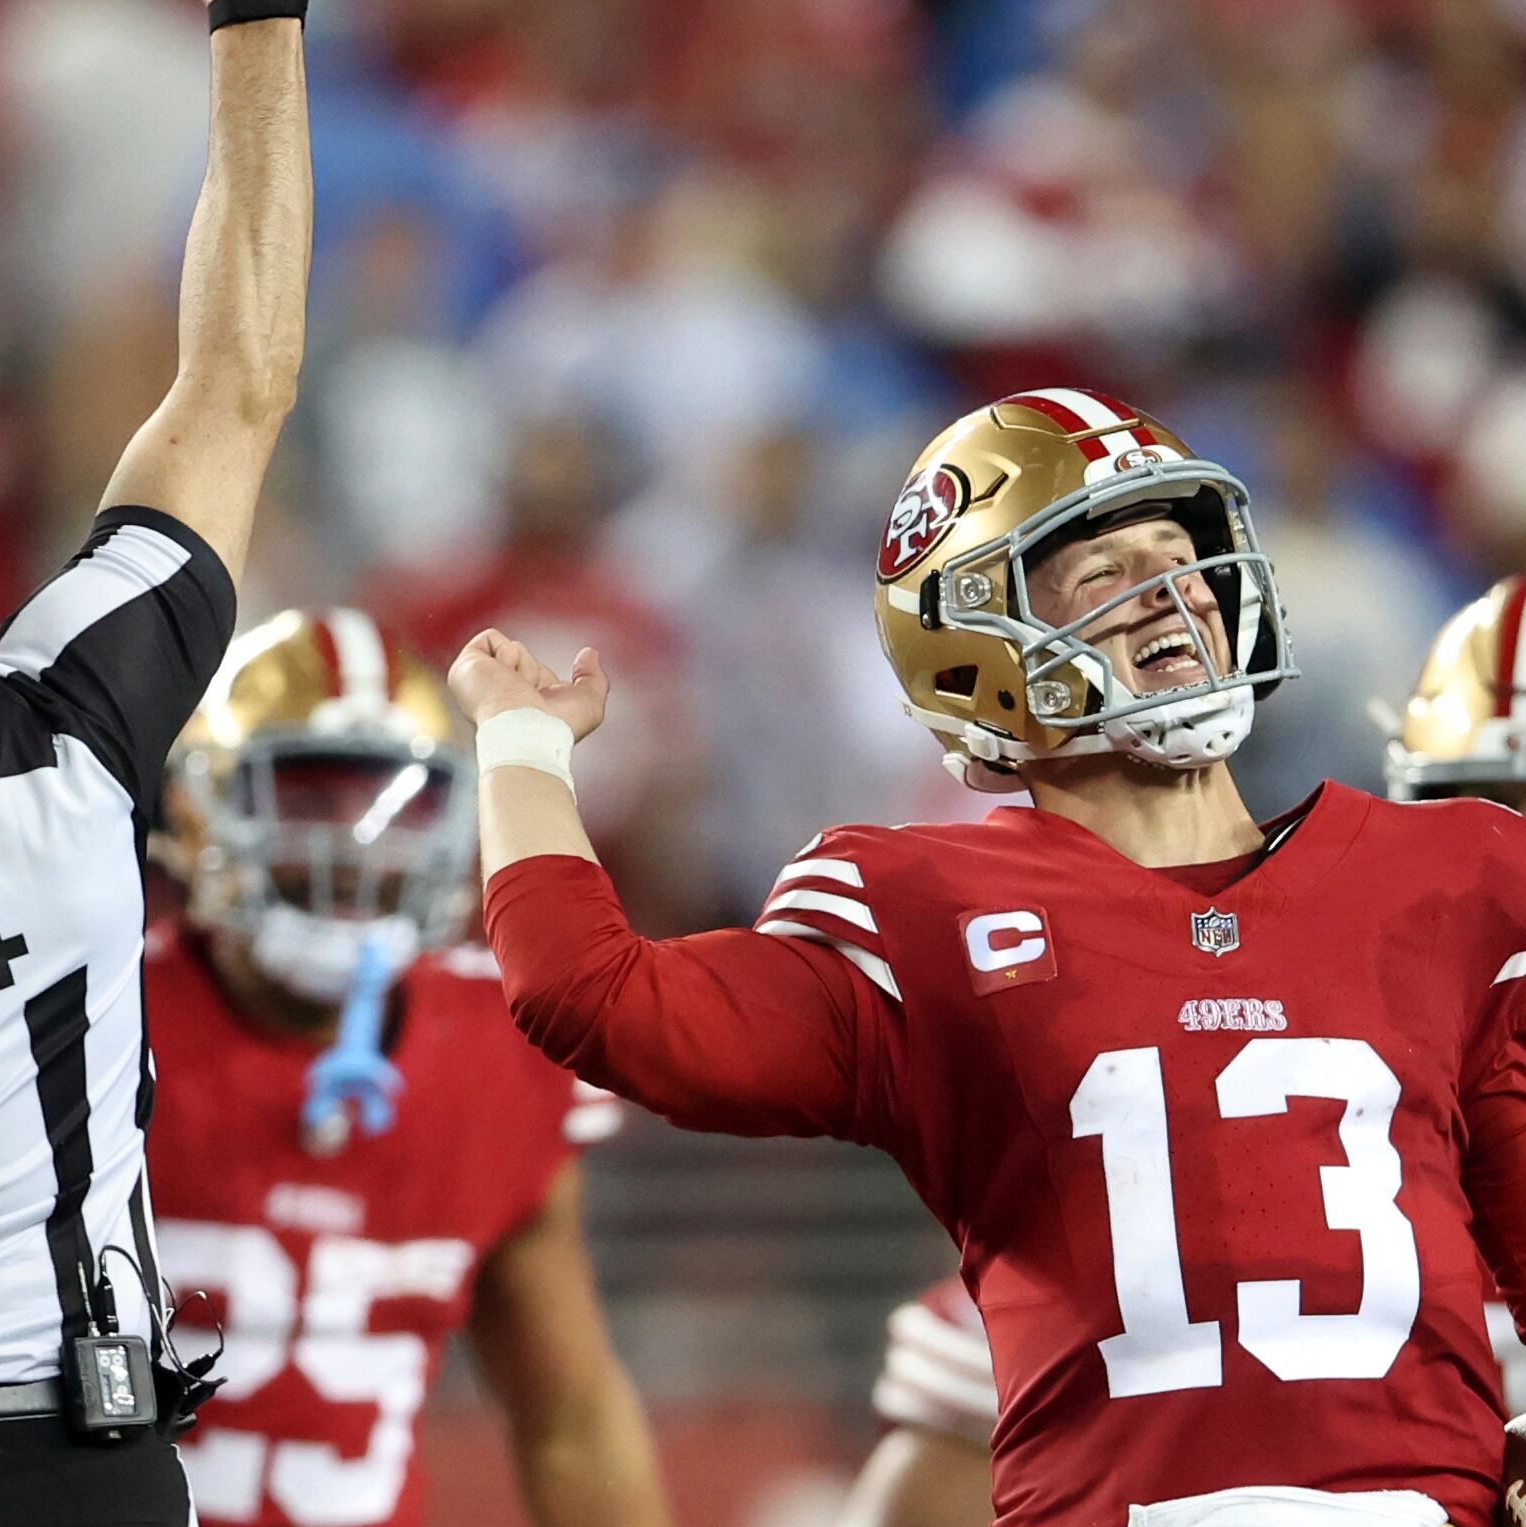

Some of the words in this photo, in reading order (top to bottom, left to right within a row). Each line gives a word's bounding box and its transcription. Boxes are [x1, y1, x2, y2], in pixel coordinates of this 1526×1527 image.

[965, 910, 1047, 973] C
[1177, 998, 1287, 1031] 49ERS
[1070, 1037, 1422, 1398] 13
